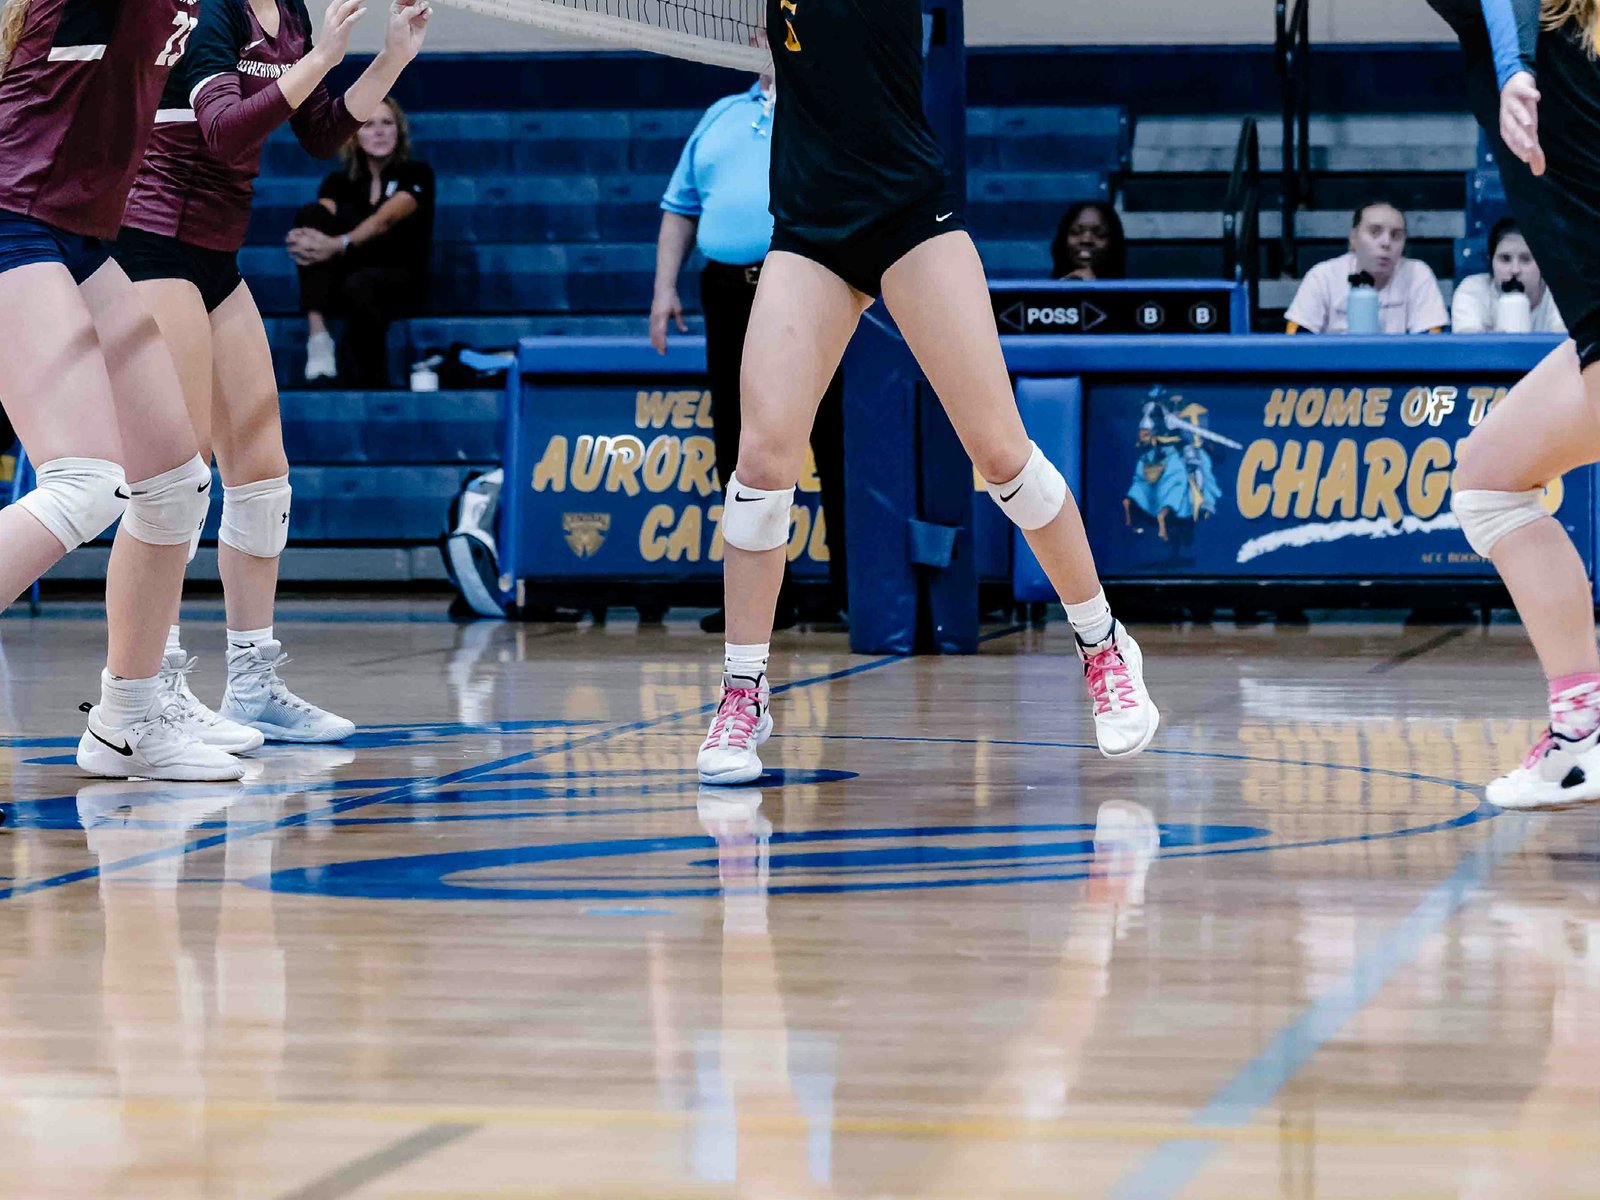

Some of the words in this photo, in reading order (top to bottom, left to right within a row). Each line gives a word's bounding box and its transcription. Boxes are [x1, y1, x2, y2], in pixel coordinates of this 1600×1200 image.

[1027, 307, 1079, 325] POSS
[1143, 307, 1159, 325] B
[1195, 307, 1211, 325] B
[1263, 387, 1393, 427] HOME
[1400, 385, 1457, 428] OF
[532, 434, 722, 497] AUROR
[1236, 437, 1564, 522] CHARG
